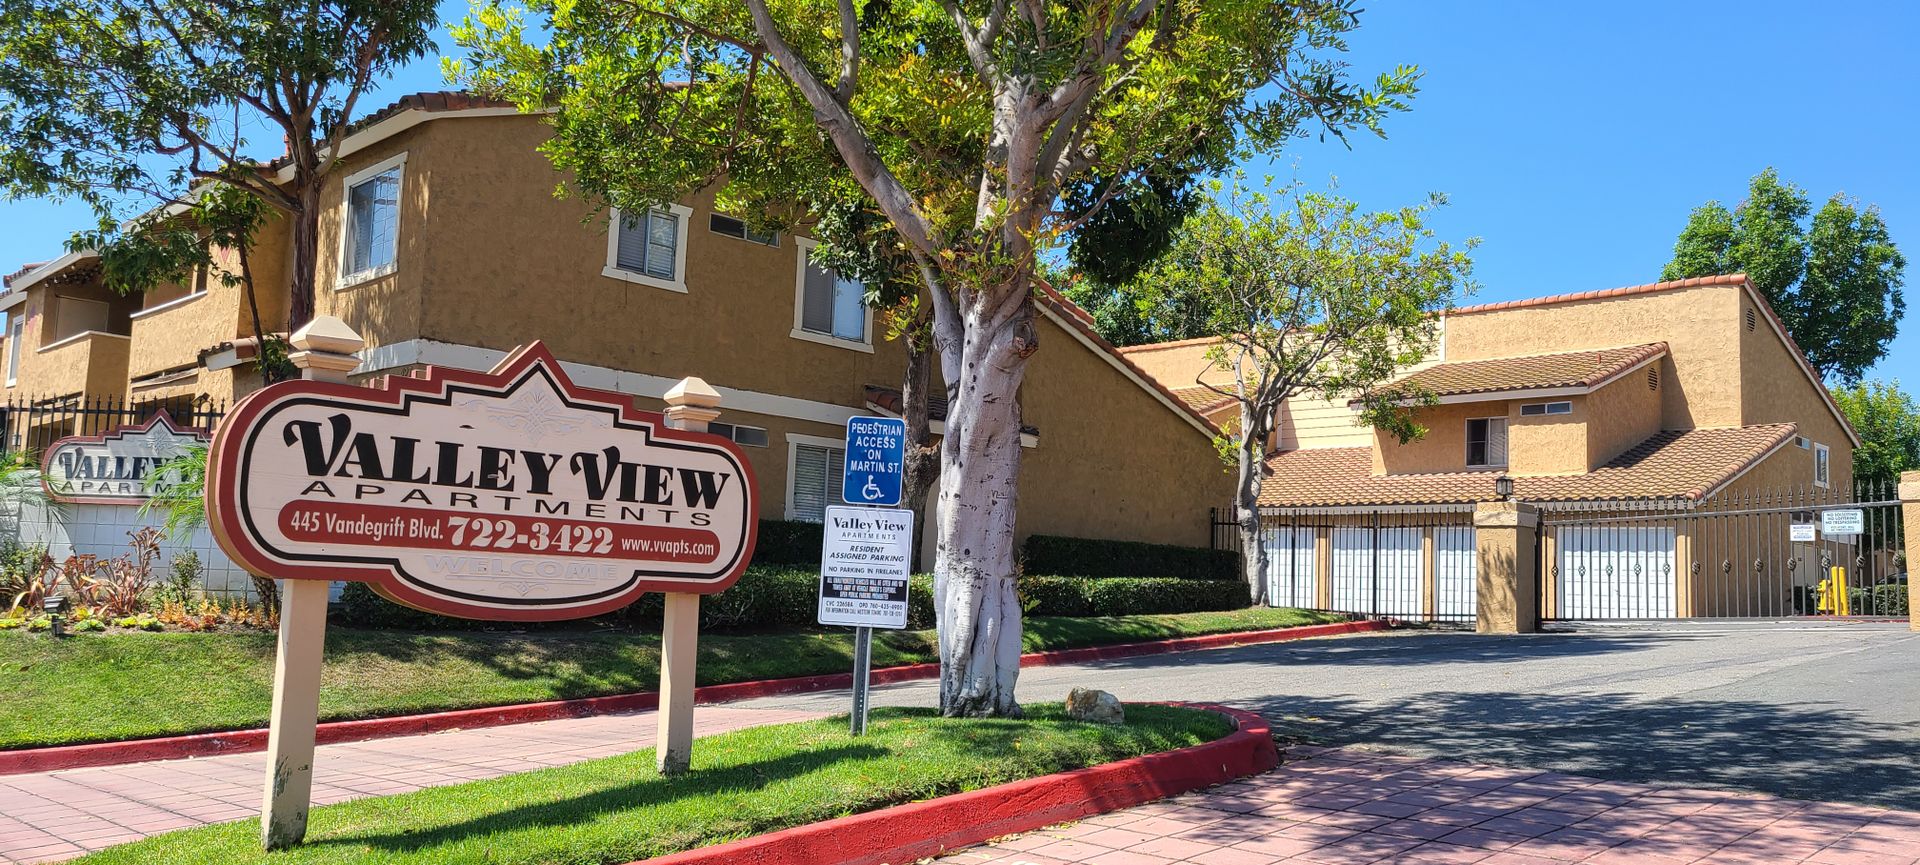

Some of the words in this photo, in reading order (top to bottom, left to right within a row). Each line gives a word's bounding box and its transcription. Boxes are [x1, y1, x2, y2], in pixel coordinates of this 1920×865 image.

[851, 423, 902, 436] PEDESTRIAN
[856, 436, 896, 449] ACCESS
[283, 413, 563, 495] VALLEY
[570, 446, 730, 509] VIEW
[867, 449, 882, 460] ON
[850, 460, 885, 473] MARTIN
[887, 462, 900, 474] ST.
[300, 480, 712, 526] APARTMENTS
[833, 517, 873, 533] Valley
[875, 519, 906, 532] View
[290, 510, 320, 532] 445
[325, 512, 405, 541] Vandegrift
[409, 523, 444, 539] Blvd.
[448, 516, 613, 554] 722-3422
[621, 537, 714, 558] www.vvapts.com
[842, 531, 896, 540] APARTMENTS
[850, 545, 885, 553] RESIDENT
[830, 552, 867, 560] ASSIGNED
[870, 554, 905, 562] PARKING
[424, 554, 618, 580] WELCOME
